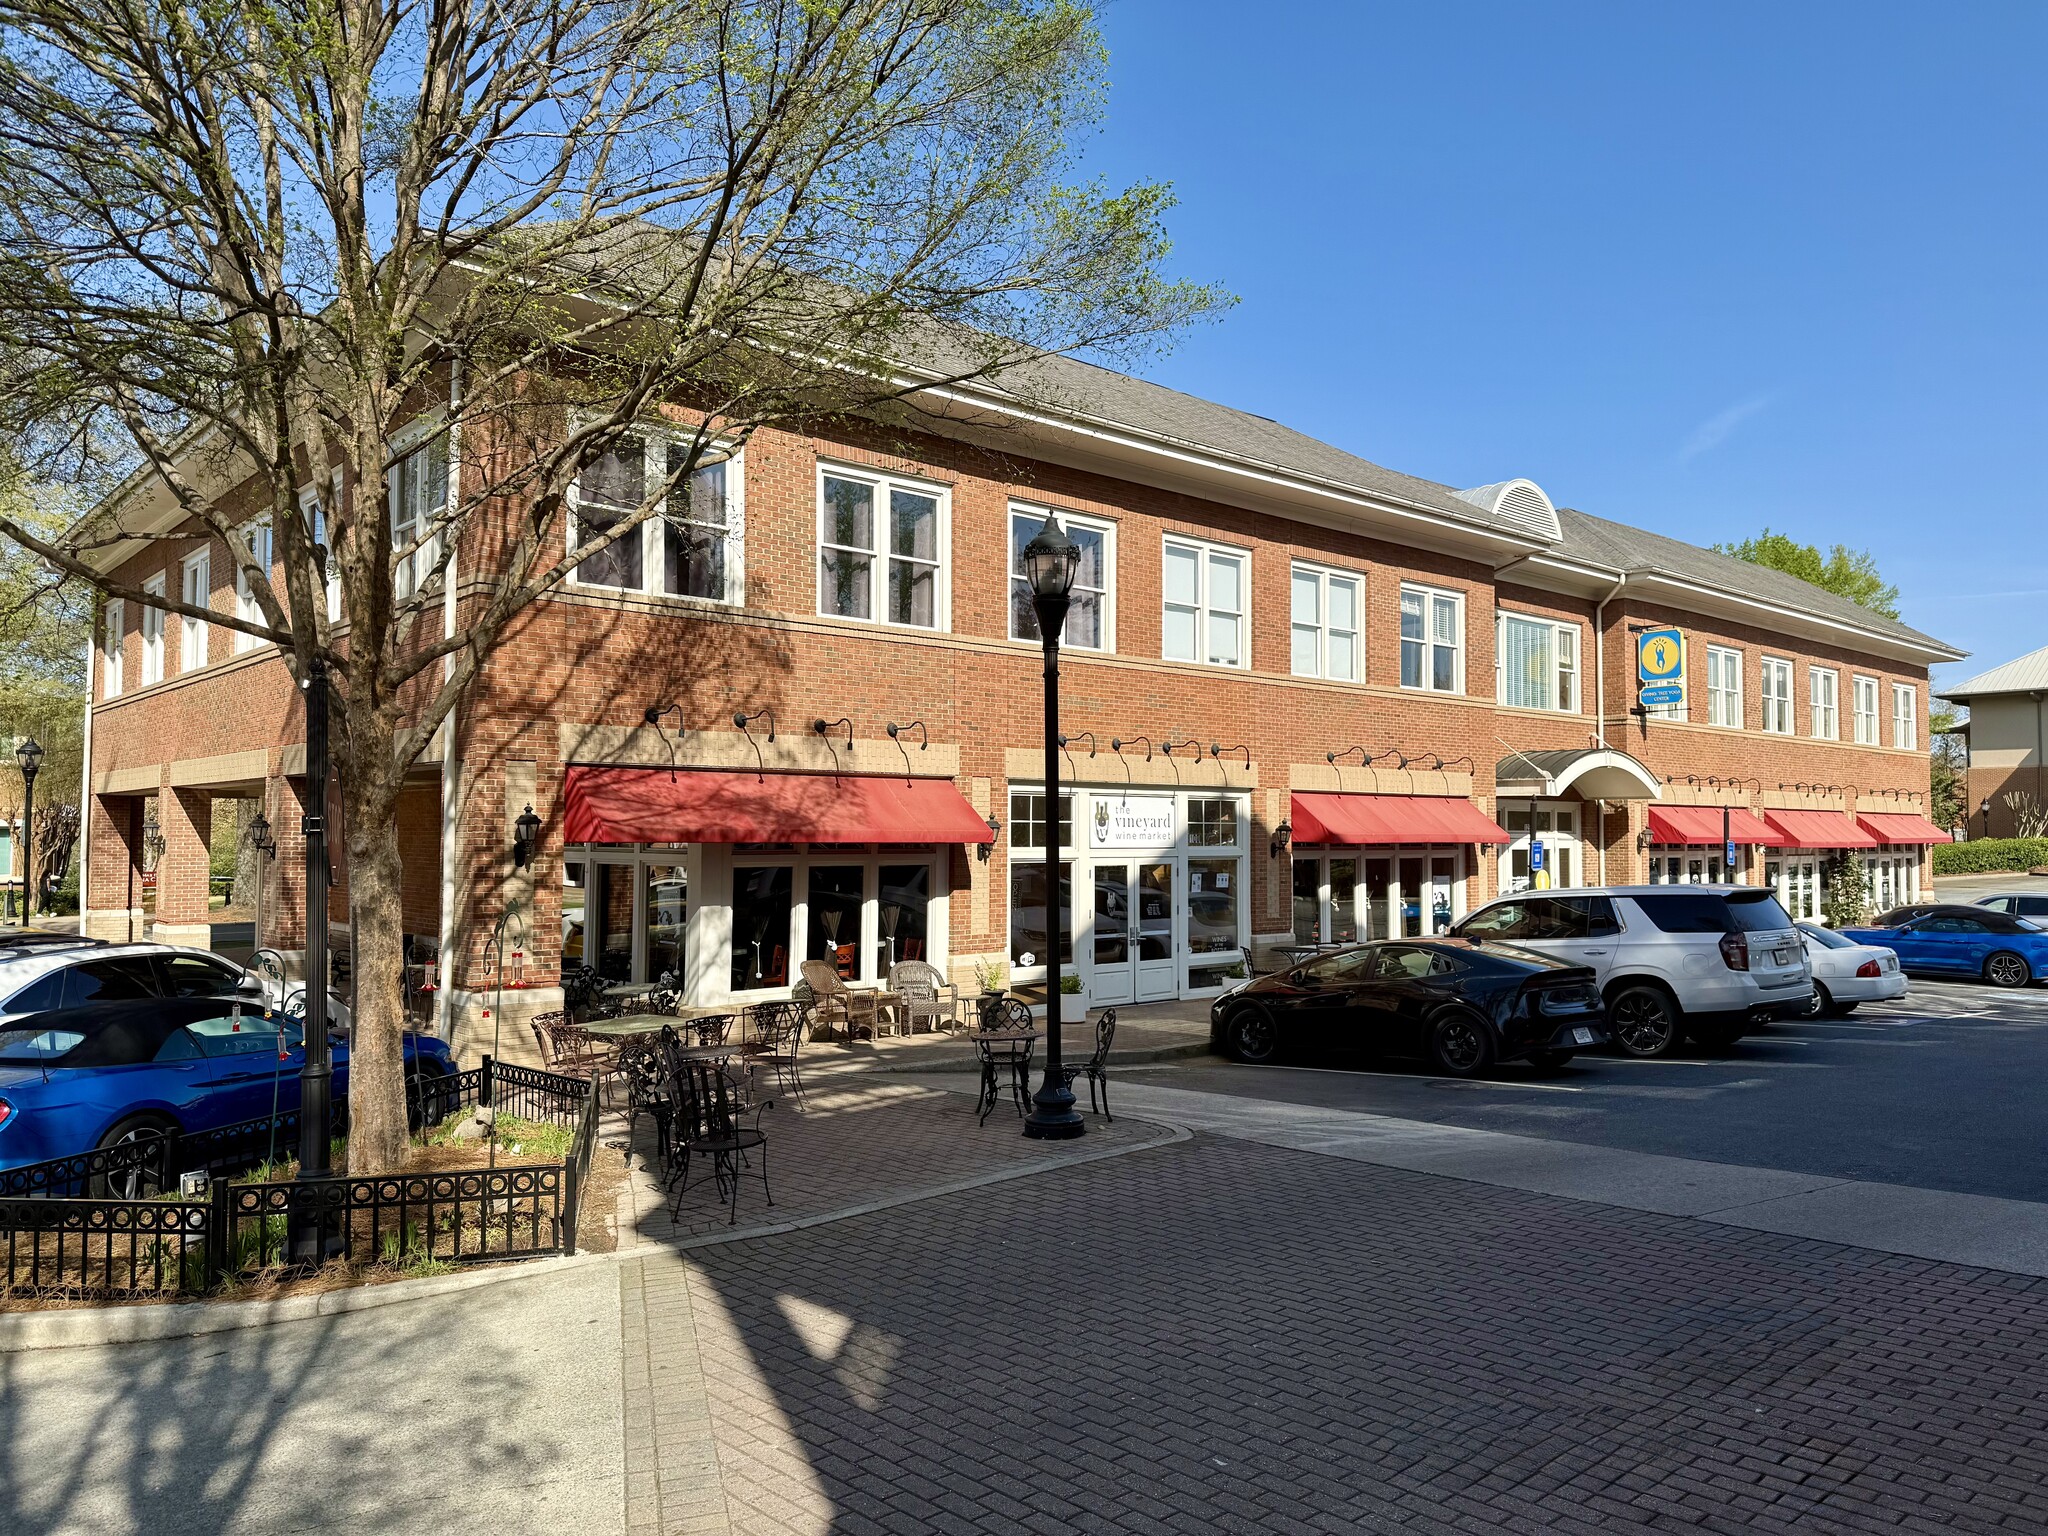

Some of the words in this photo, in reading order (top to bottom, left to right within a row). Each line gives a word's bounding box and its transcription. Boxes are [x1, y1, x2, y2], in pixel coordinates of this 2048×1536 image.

[1115, 806, 1131, 814] the
[1115, 813, 1171, 831] vineyard
[1115, 832, 1137, 840] wine
[1139, 831, 1171, 840] market
